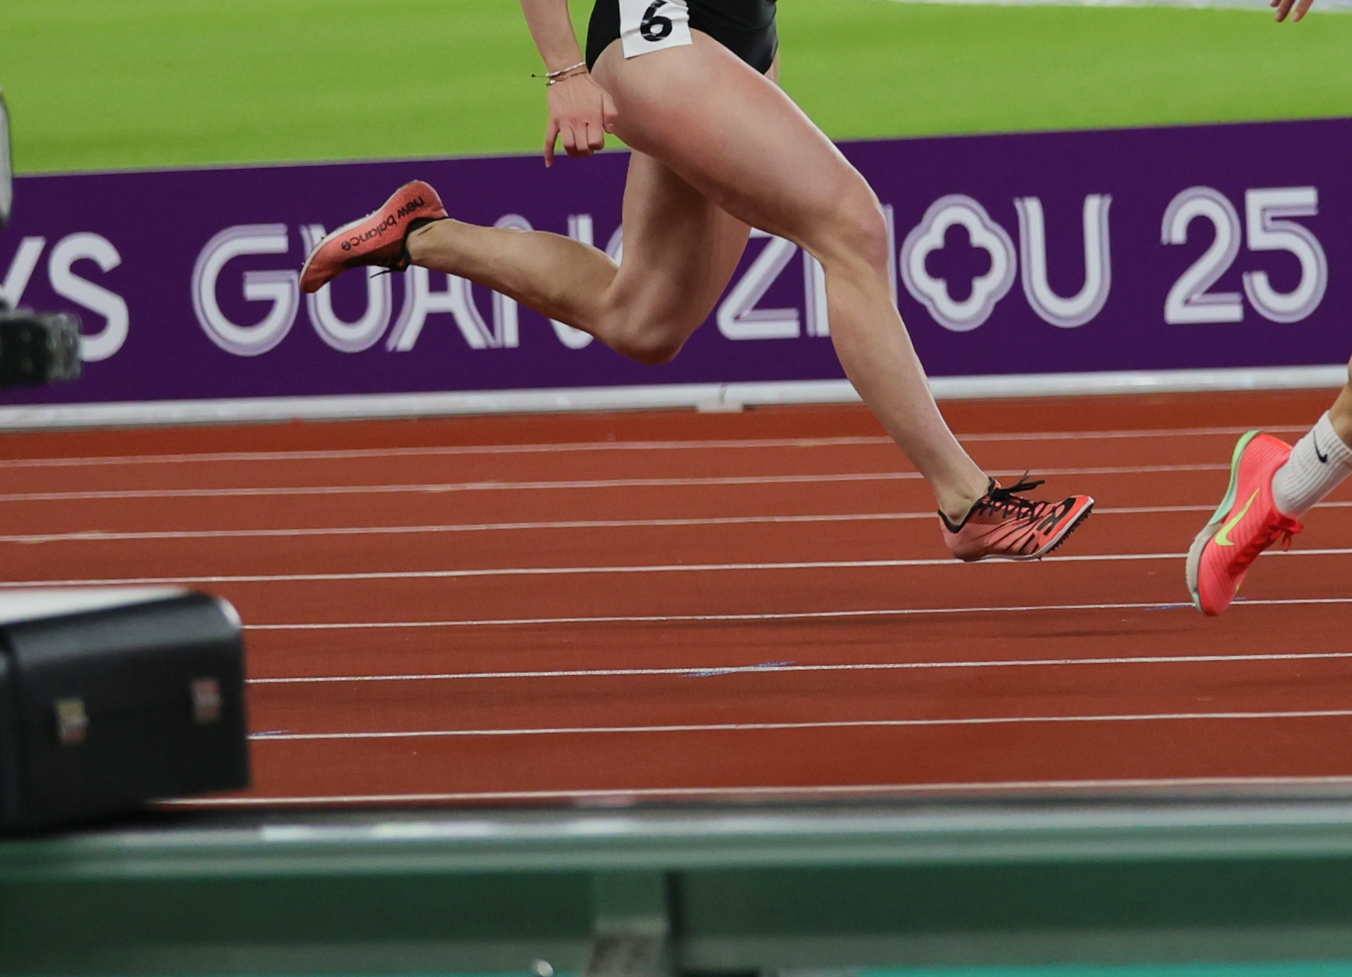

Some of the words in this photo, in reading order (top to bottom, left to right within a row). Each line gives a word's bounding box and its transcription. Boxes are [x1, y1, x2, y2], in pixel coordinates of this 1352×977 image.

[397, 196, 425, 220] new
[341, 214, 398, 251] balance
[1161, 186, 1328, 325] 25
